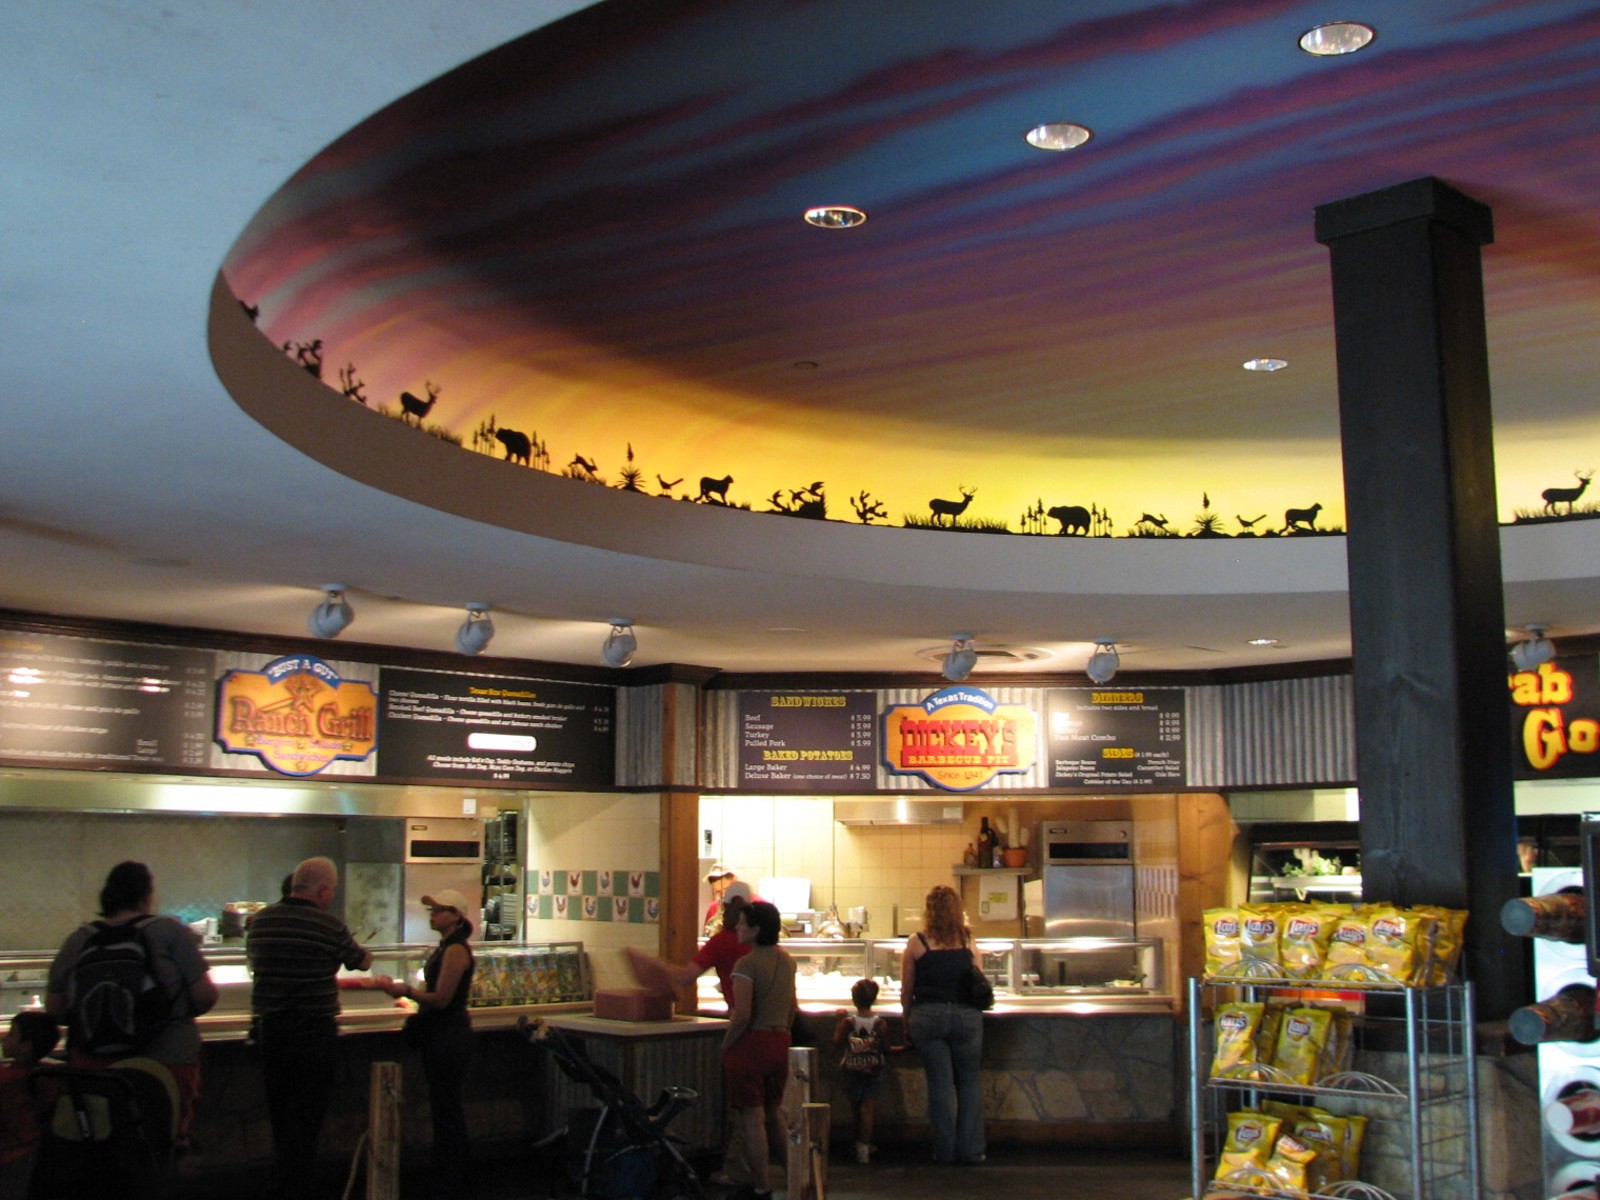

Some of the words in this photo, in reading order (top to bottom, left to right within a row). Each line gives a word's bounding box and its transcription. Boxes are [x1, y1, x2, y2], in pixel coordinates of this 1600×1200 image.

[302, 660, 310, 669] A
[926, 702, 934, 711] A
[932, 693, 958, 705] Texas
[959, 692, 994, 709] Tradition
[230, 696, 314, 736] Ranch
[319, 702, 372, 742] Grill
[763, 750, 798, 760] BAKED
[800, 750, 854, 760] POTATOES
[908, 755, 982, 764] BARBECUE
[986, 755, 1010, 764] PIT
[937, 770, 960, 780] Since
[964, 770, 983, 780] 1941
